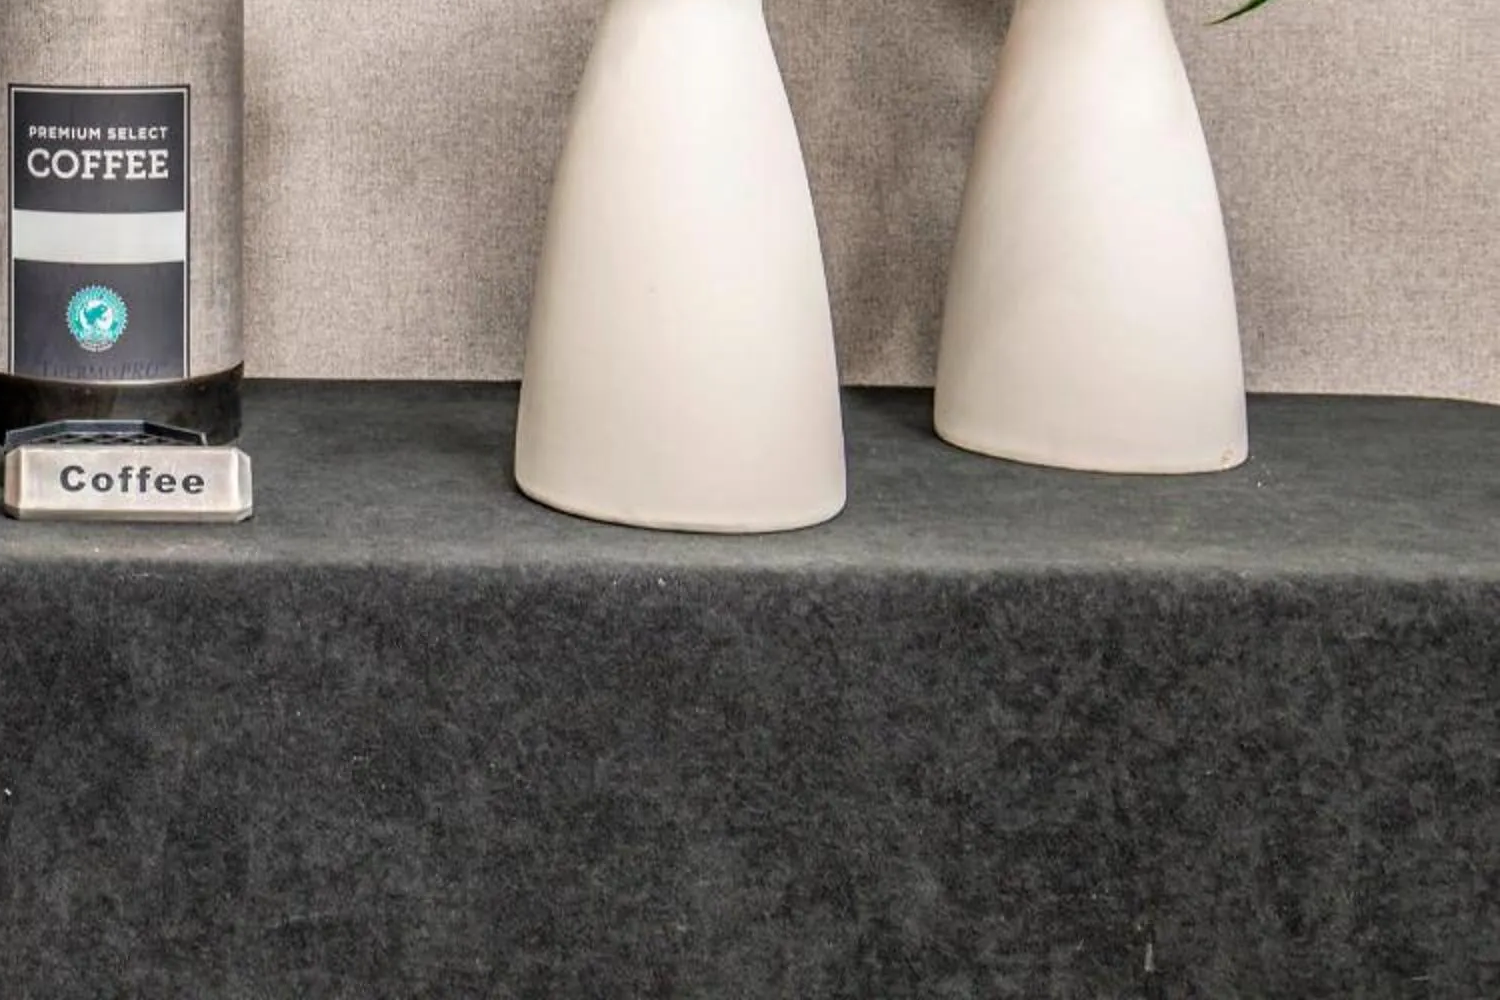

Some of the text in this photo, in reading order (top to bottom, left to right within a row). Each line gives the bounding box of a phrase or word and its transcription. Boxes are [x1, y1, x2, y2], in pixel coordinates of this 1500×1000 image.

[29, 125, 169, 141] PREMIUM SELECT
[27, 148, 169, 180] COFFEE
[59, 464, 205, 495] Coffee
